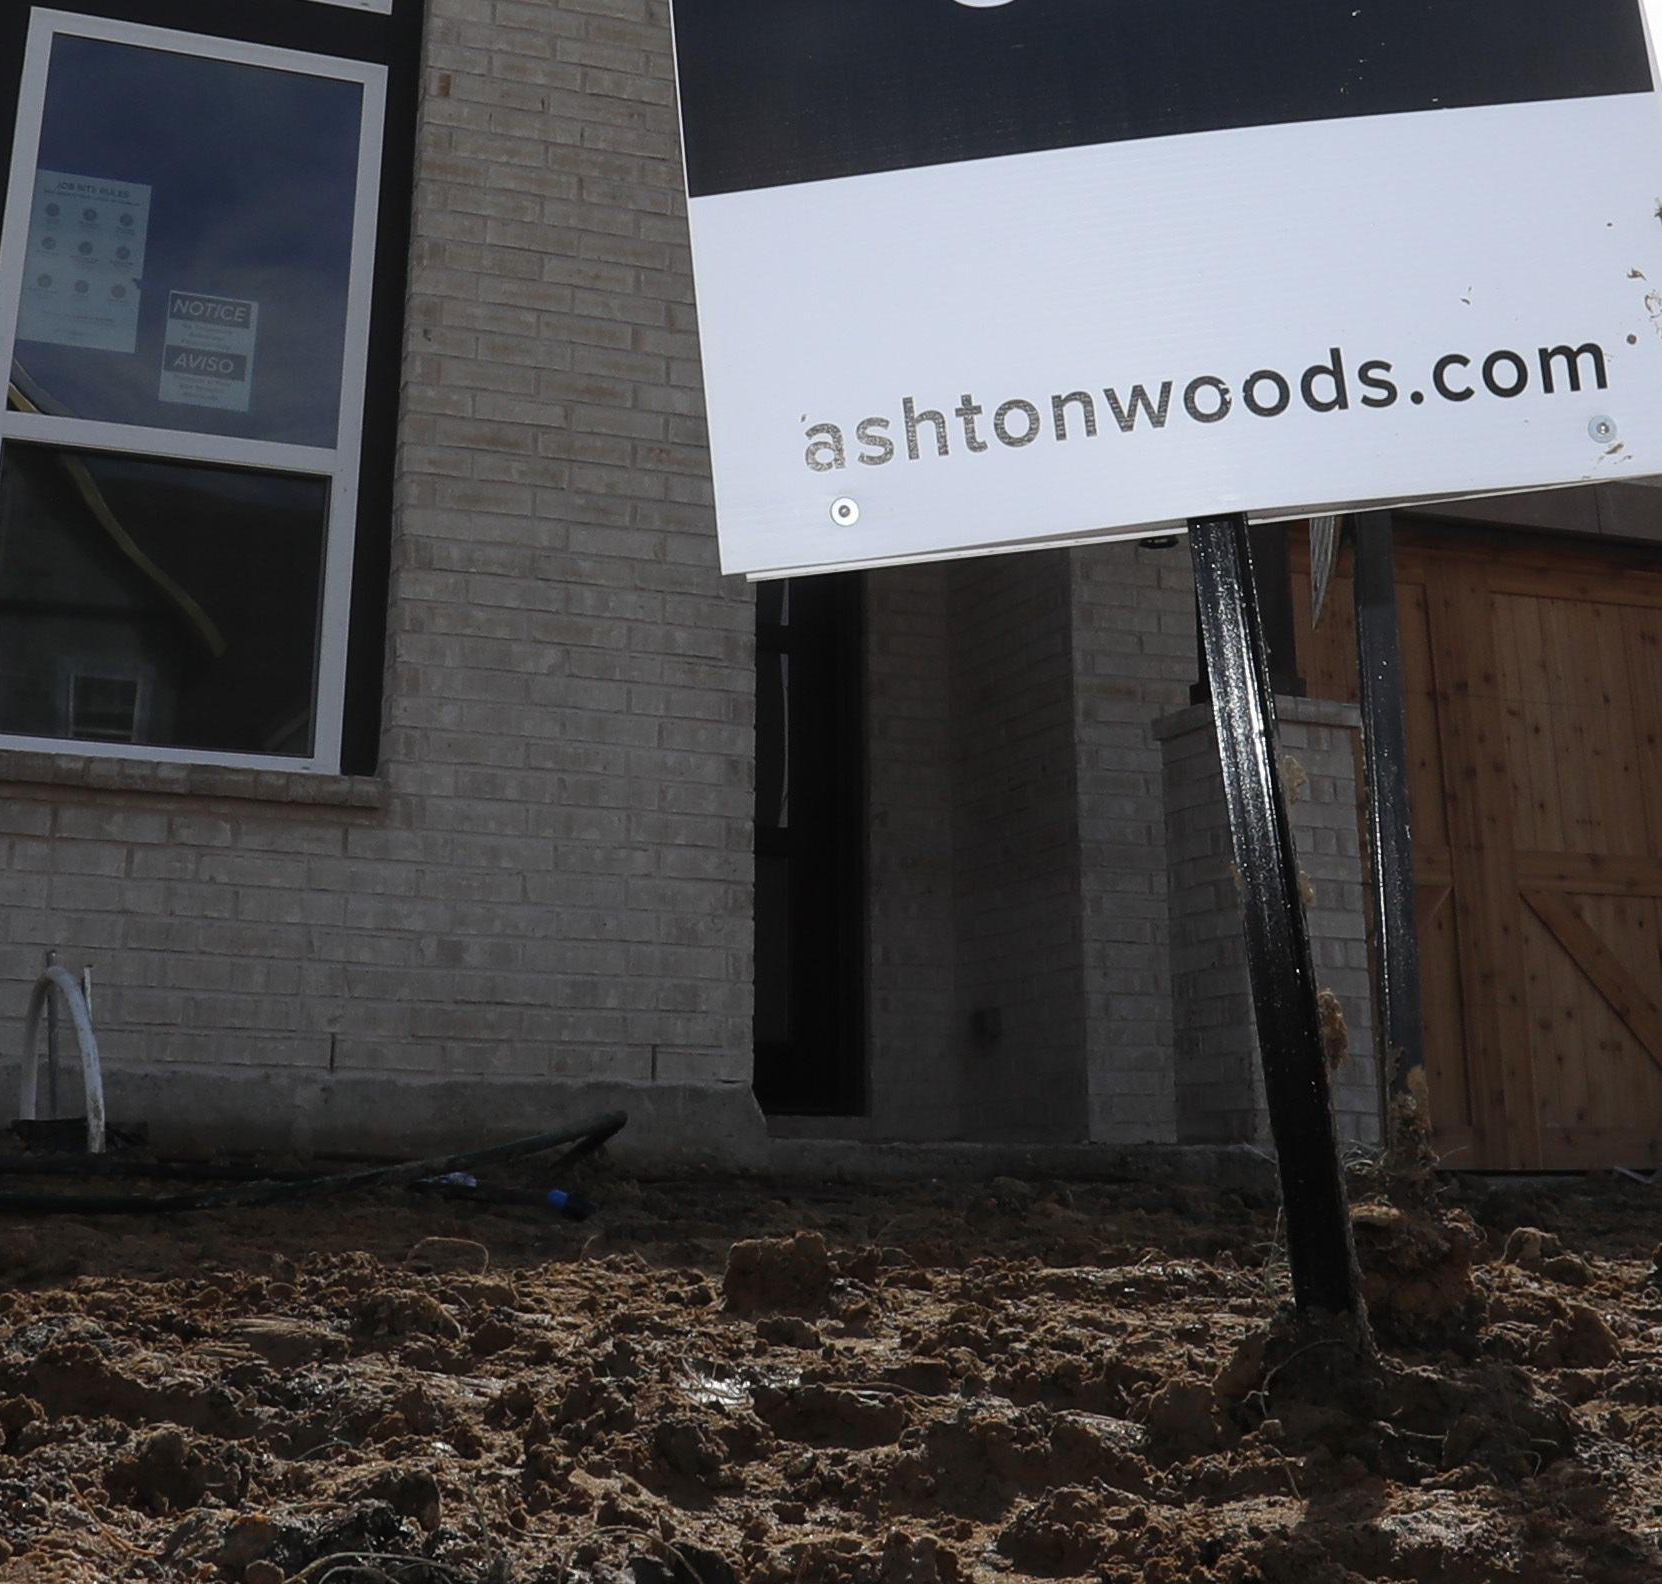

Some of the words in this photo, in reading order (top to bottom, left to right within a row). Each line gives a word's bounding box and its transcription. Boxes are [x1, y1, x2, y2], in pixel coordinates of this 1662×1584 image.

[174, 298, 247, 322] NOTICE
[172, 352, 234, 374] AVISO
[803, 342, 1609, 471] ashtonwoods.com
